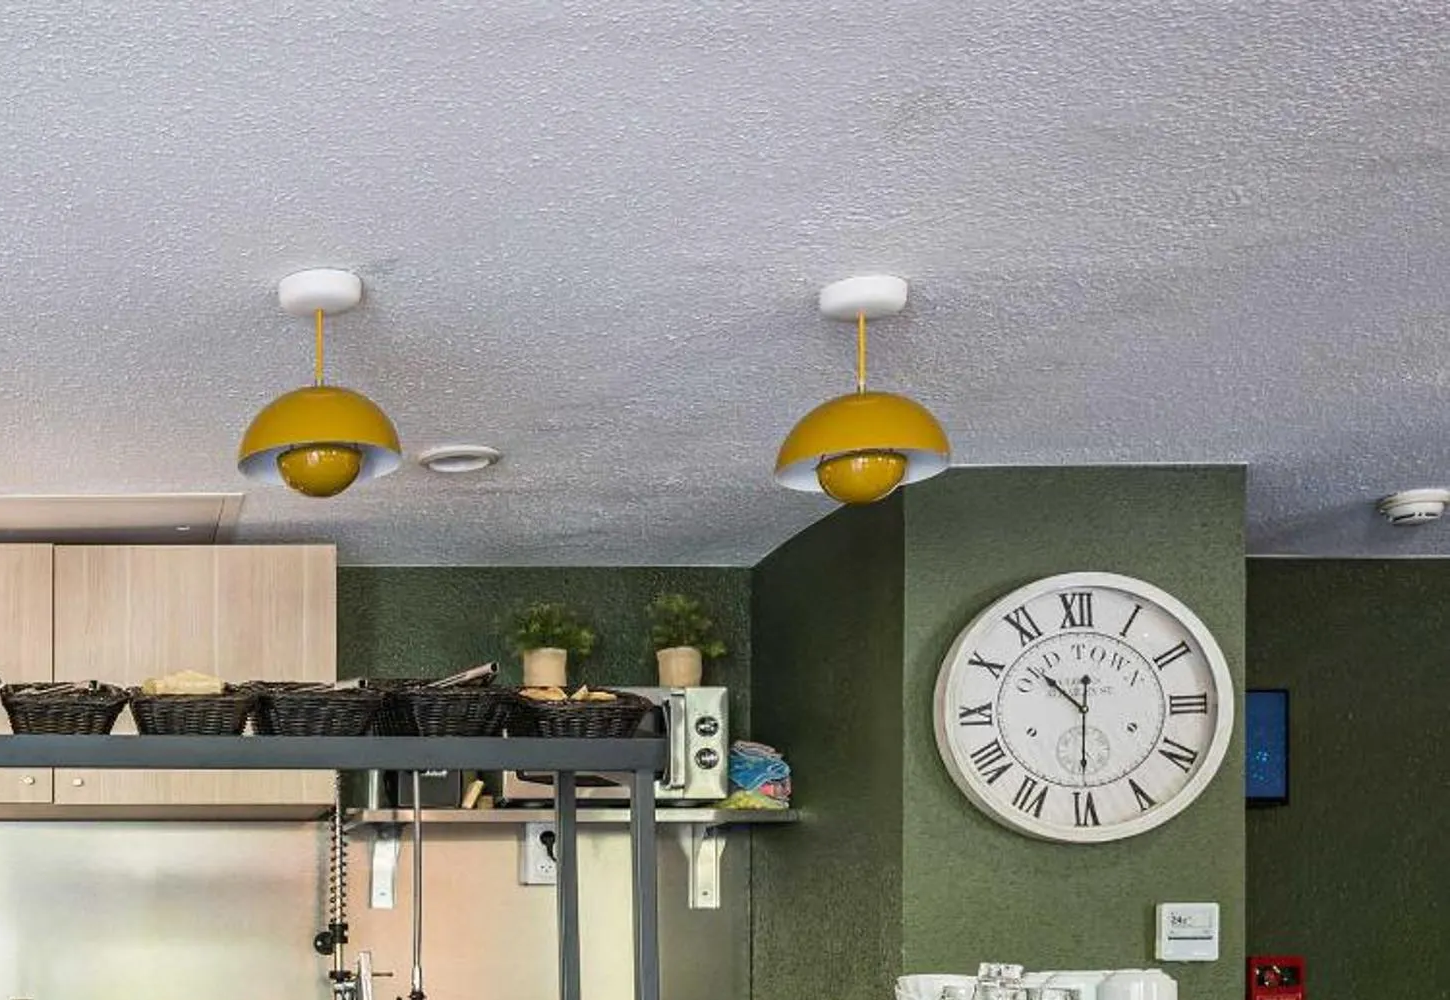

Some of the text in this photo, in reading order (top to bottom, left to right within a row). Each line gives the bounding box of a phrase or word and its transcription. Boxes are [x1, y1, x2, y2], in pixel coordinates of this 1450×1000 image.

[1003, 605, 1043, 646] XI
[1058, 592, 1094, 629] XII
[1119, 604, 1143, 637] I
[968, 650, 1006, 679] X
[1016, 643, 1146, 693] OLD TOWN
[1152, 641, 1191, 670] II
[959, 702, 993, 726] IX
[1169, 692, 1207, 715] III
[970, 738, 1014, 785] VIII
[1158, 738, 1198, 773] IV
[1011, 775, 1048, 818] VII
[1072, 791, 1101, 827] VI
[1128, 778, 1158, 812] V
